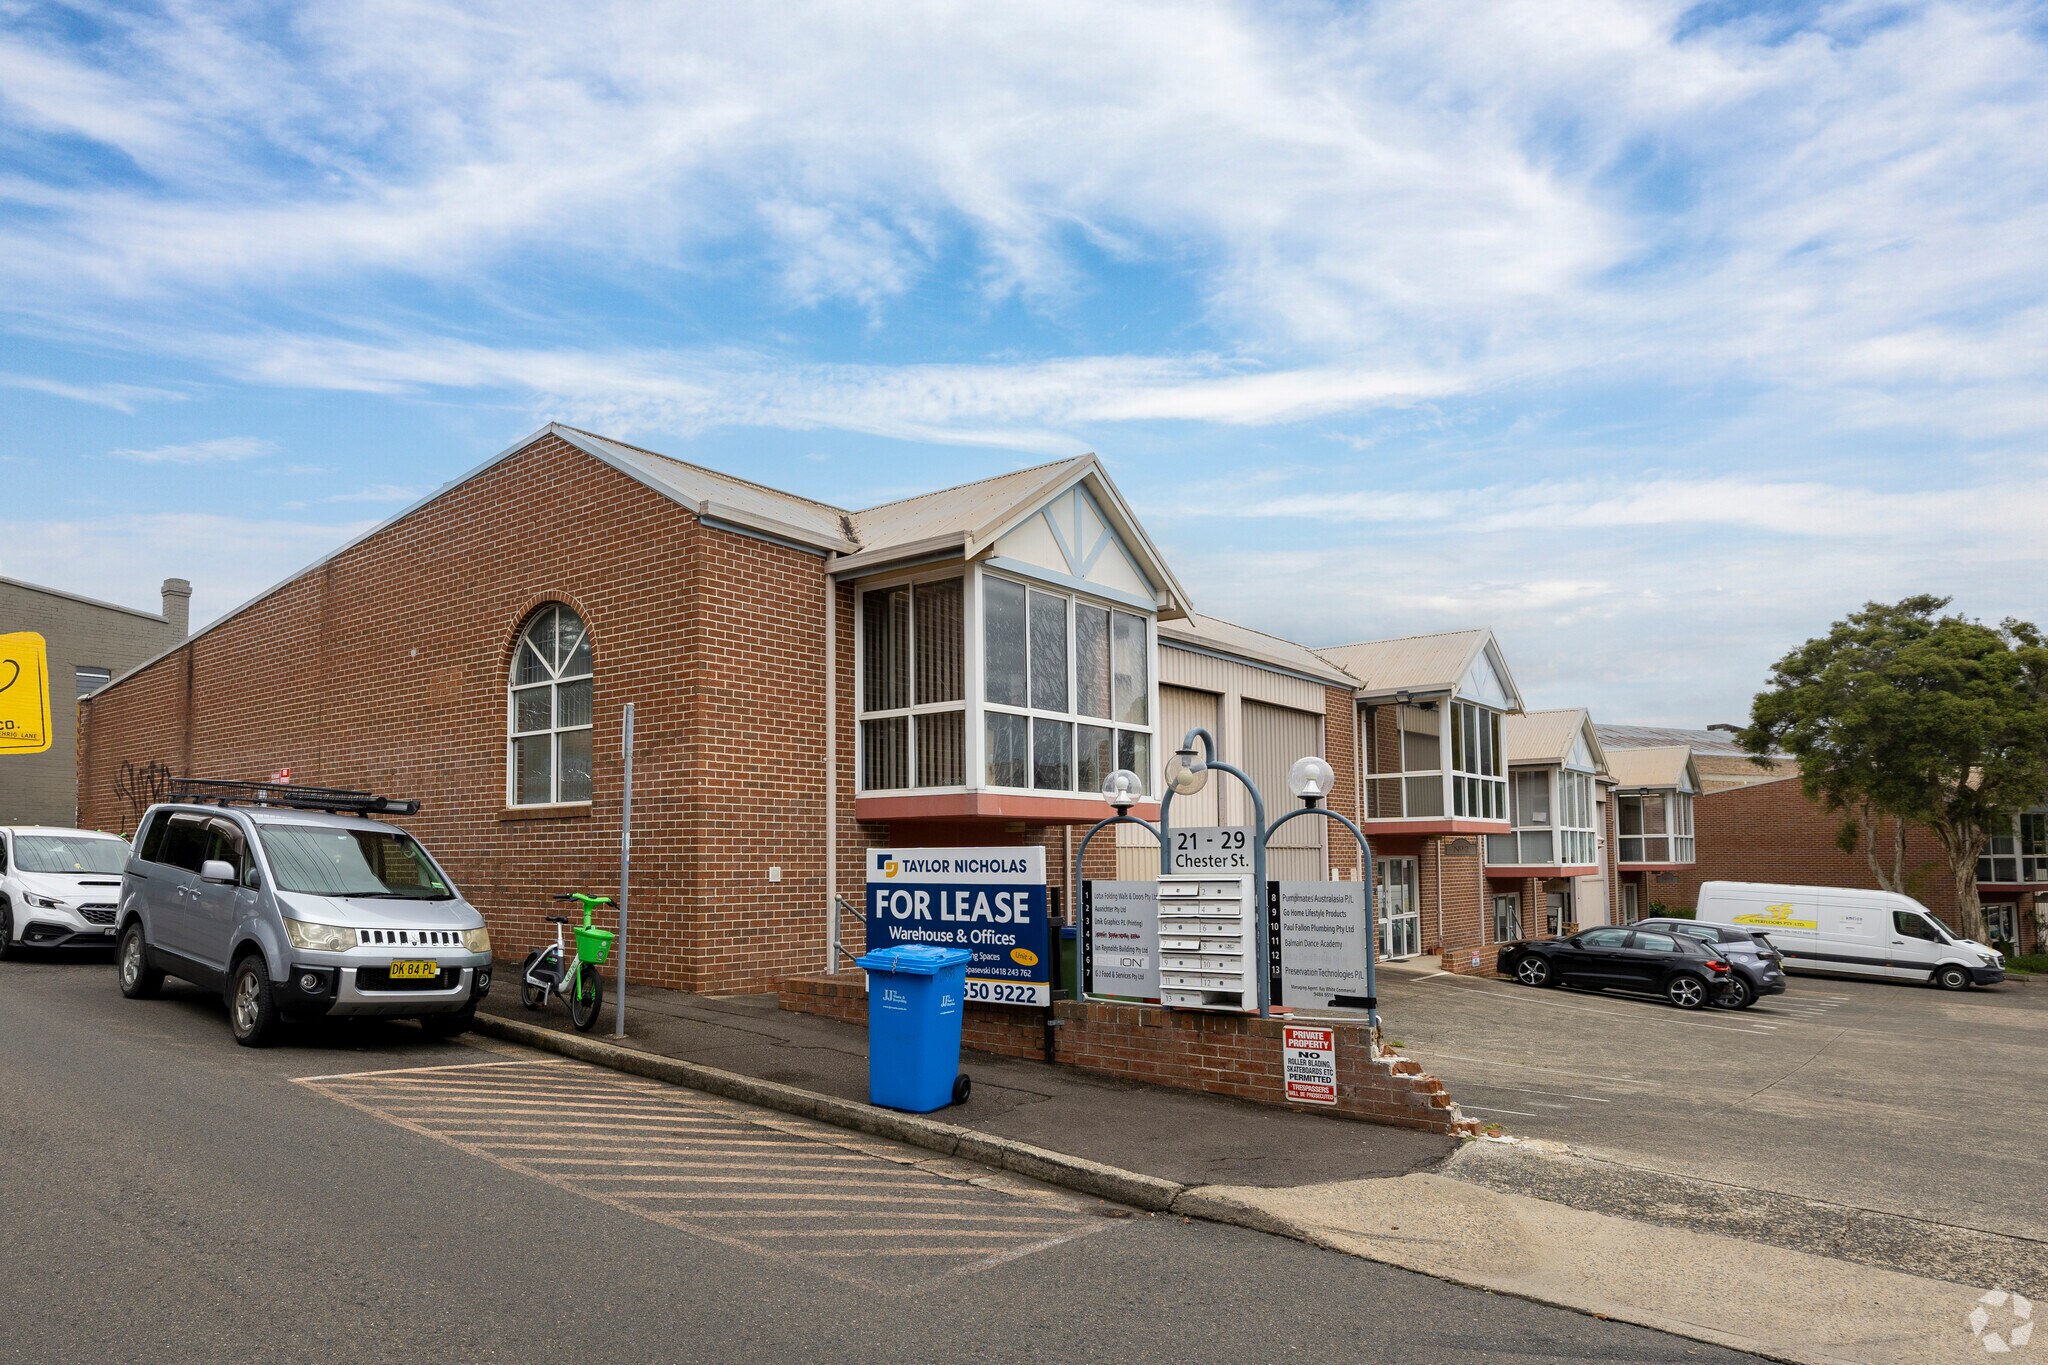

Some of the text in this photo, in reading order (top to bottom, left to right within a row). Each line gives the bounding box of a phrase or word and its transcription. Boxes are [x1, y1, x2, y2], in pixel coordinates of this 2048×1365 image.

[1178, 832, 1197, 850] 21
[1221, 831, 1245, 849] 29
[1176, 853, 1249, 867] Chester St.
[902, 859, 1027, 873] TAYLOR NICHOLAS
[1104, 892, 1117, 901] Folding
[1314, 894, 1343, 903] Australasia
[1345, 895, 1354, 904] P/L
[876, 889, 1030, 924] FOR LEASE
[1305, 909, 1324, 919] Lifestyle
[1127, 920, 1143, 928] (Printing)
[1311, 924, 1335, 934] Plumbing
[1336, 925, 1344, 934] Pty
[889, 926, 1016, 945] Warehouse & Offices
[1102, 944, 1118, 952] Reynolds
[1119, 945, 1135, 954] Building
[1320, 940, 1342, 950] Academy
[980, 952, 1000, 962] Spaces
[1015, 952, 1027, 960] Unit
[392, 964, 434, 974] DK 84 PL
[966, 966, 990, 974] Spasevski
[1020, 969, 1032, 977] 762
[1285, 967, 1317, 976] Preservation
[1319, 968, 1353, 980] Technologies
[1355, 970, 1364, 980] P/L
[994, 984, 1036, 1004] 9222
[1293, 1031, 1324, 1040] PRIVATE
[1288, 1039, 1329, 1049] PROPERTY
[1288, 1058, 1307, 1066] ROLLER
[1287, 1066, 1322, 1075] SKATEBOARDS
[1290, 1074, 1332, 1083] PERMITTED
[1292, 1084, 1329, 1093] TRESPASSERS
